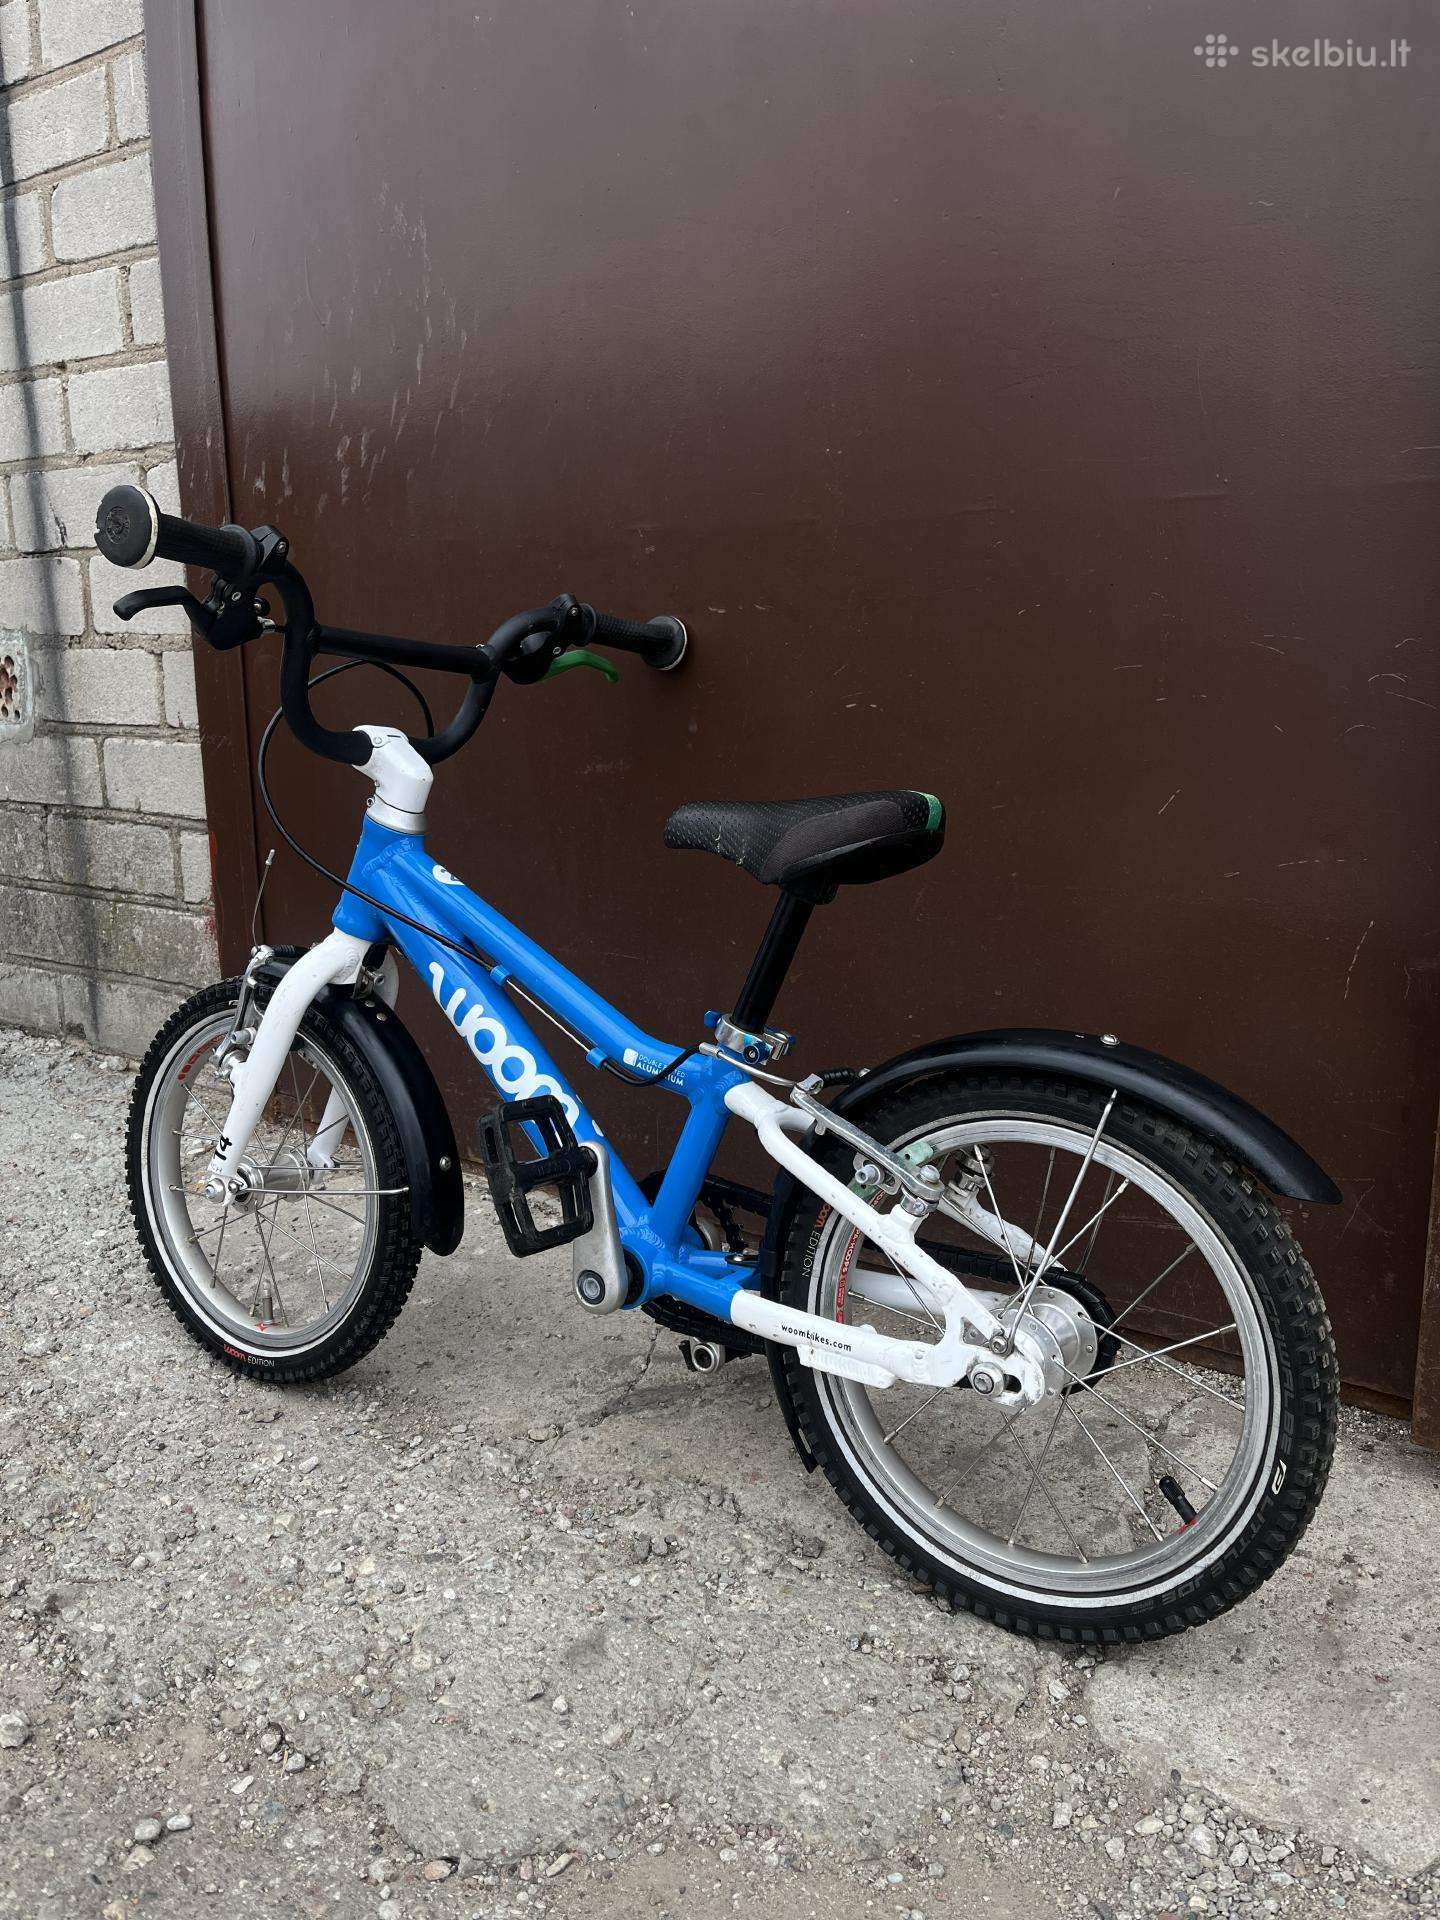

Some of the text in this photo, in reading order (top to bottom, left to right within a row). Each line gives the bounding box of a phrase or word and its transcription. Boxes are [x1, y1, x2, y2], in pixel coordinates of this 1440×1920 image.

[214, 1134, 233, 1161] 14
[802, 1230, 821, 1278] EDITION
[781, 1324, 853, 1352] woombikes.com
[223, 1343, 276, 1368] woom EDITION
